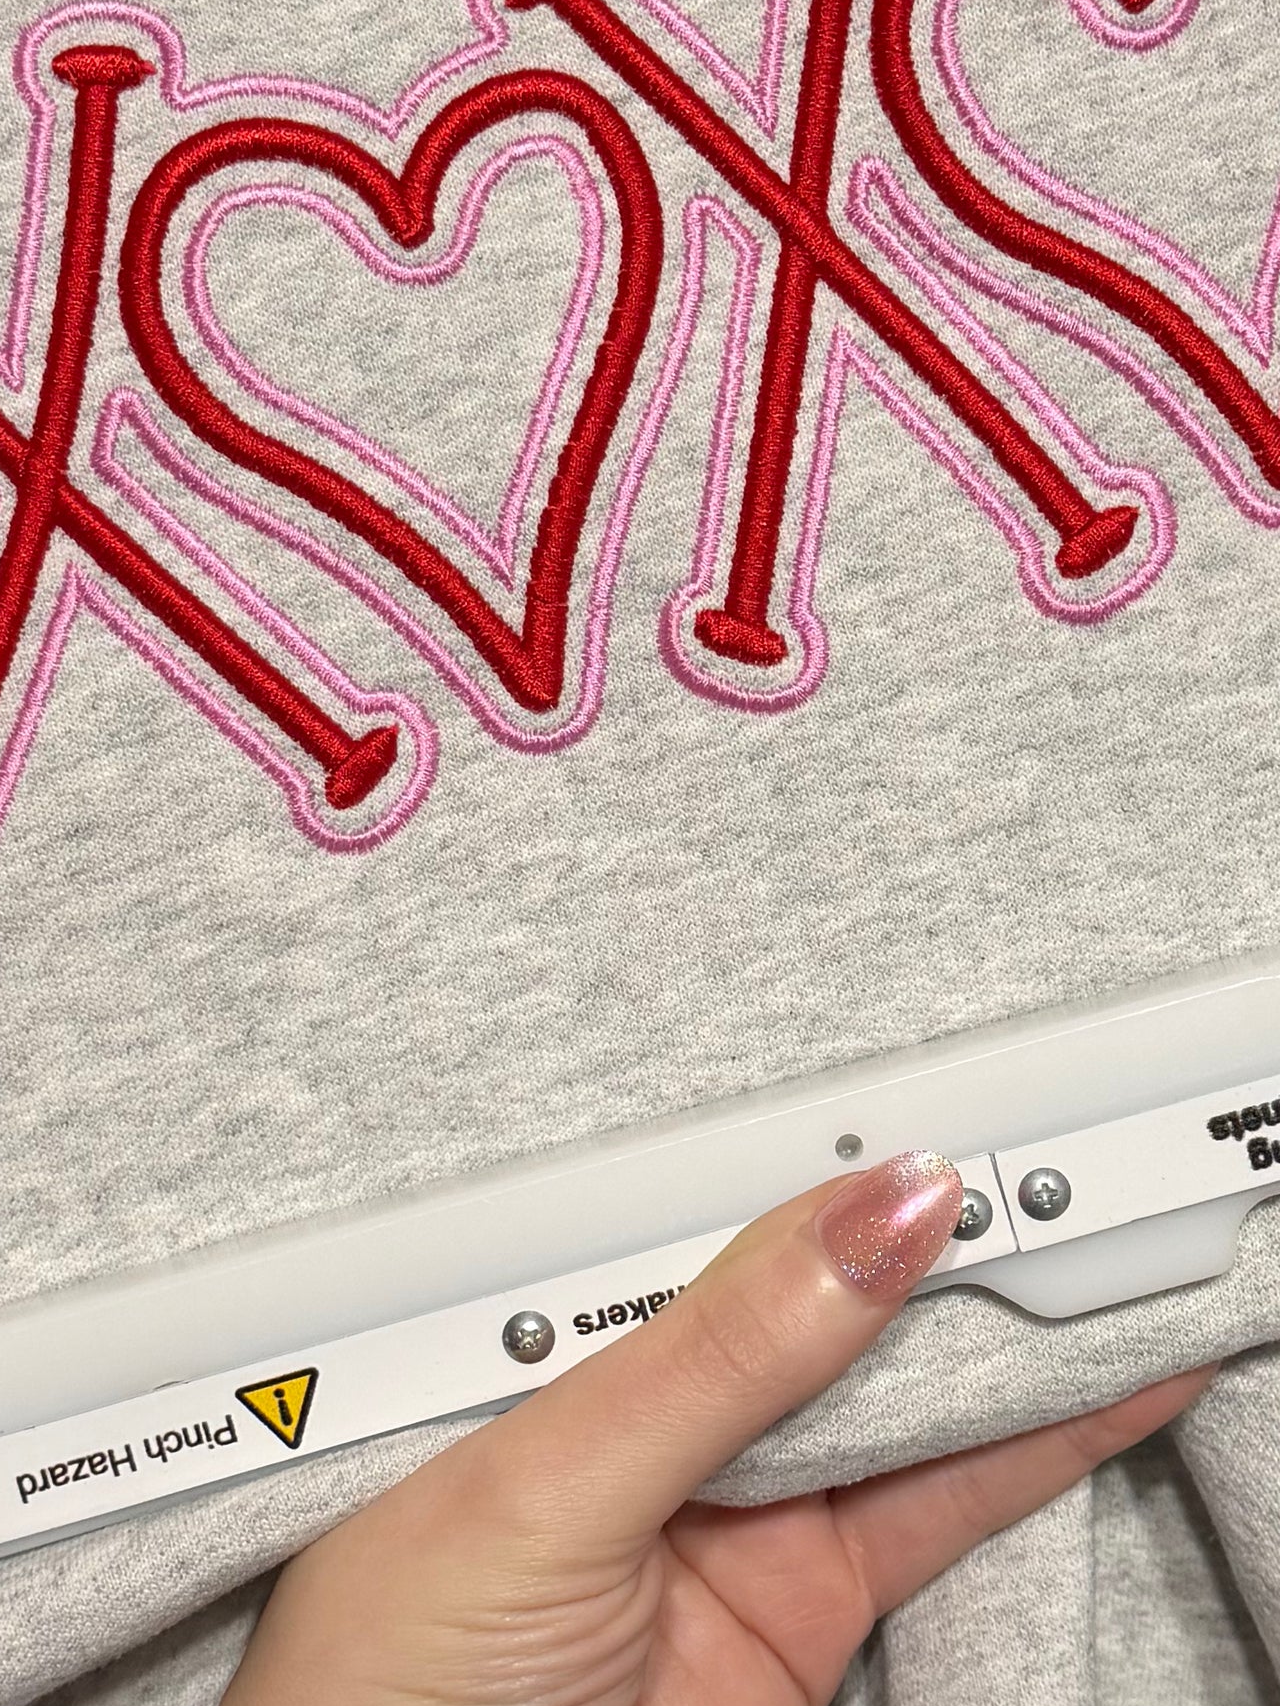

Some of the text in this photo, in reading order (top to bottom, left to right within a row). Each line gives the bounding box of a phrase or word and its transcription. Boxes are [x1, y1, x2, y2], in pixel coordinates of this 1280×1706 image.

[572, 1284, 686, 1336] akers
[15, 1414, 238, 1505] Pinch Hazard
